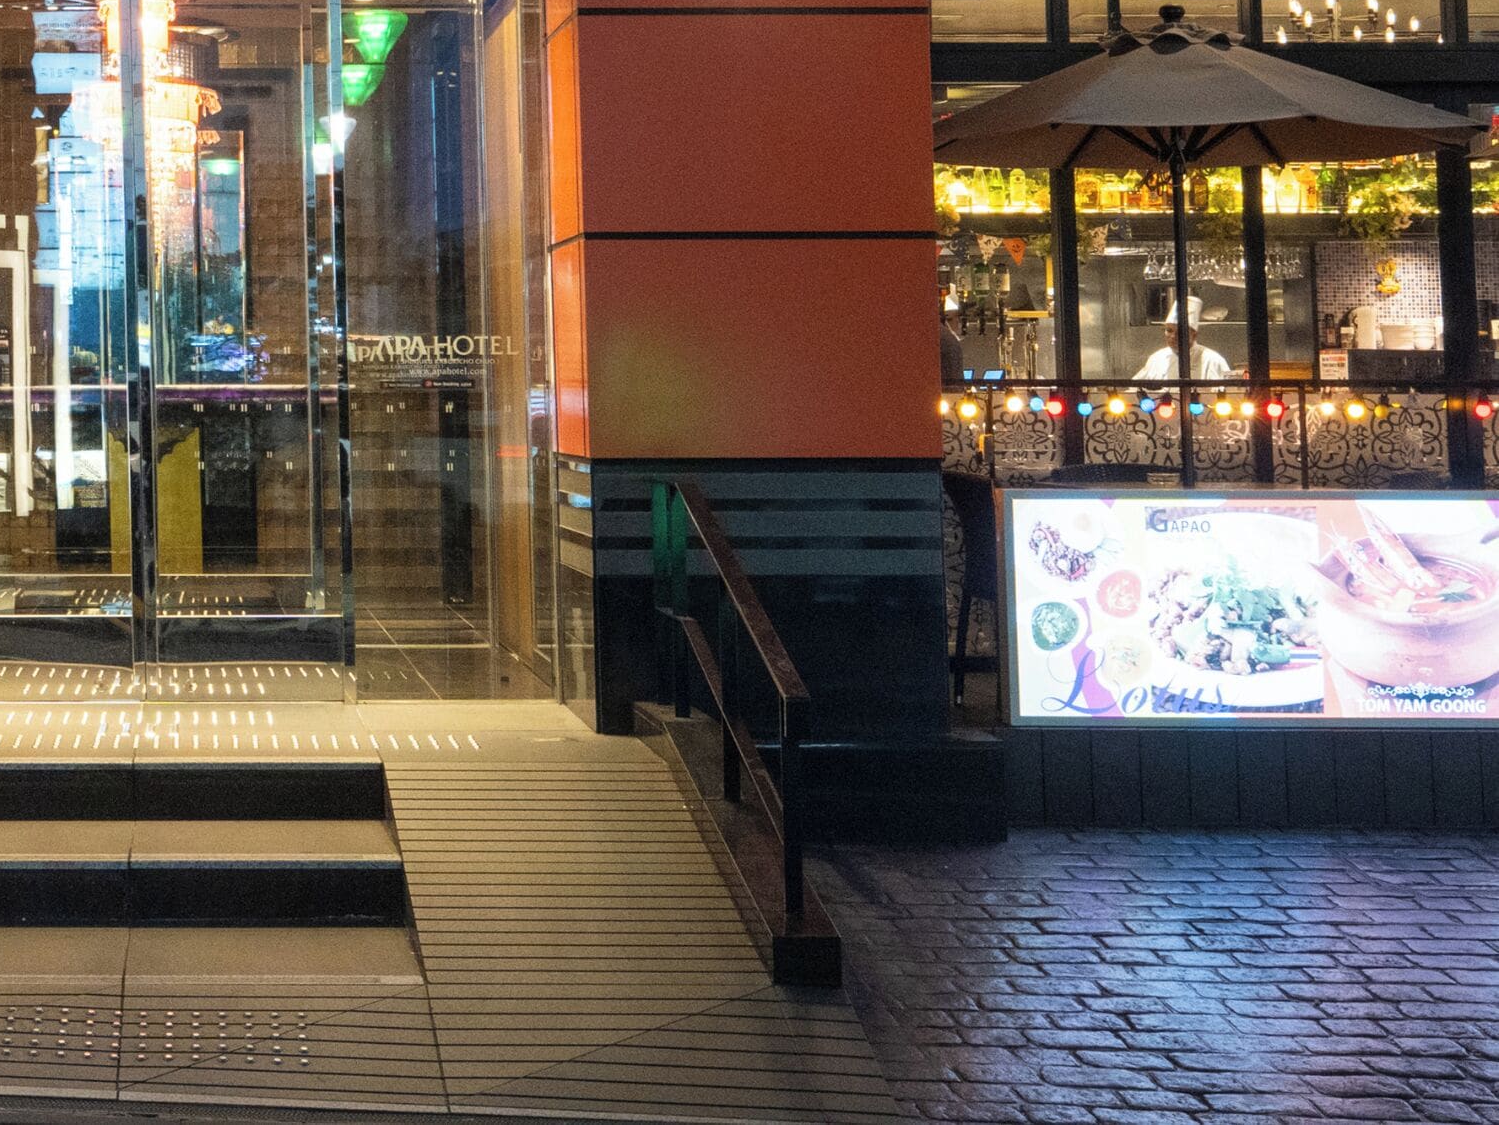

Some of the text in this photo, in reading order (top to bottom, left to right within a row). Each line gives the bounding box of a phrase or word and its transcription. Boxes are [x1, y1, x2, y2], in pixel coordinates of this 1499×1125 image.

[375, 335, 521, 356] APA HOTEL
[1149, 508, 1212, 533] GAPAO
[1357, 698, 1487, 714] TOM YAM GOONG
